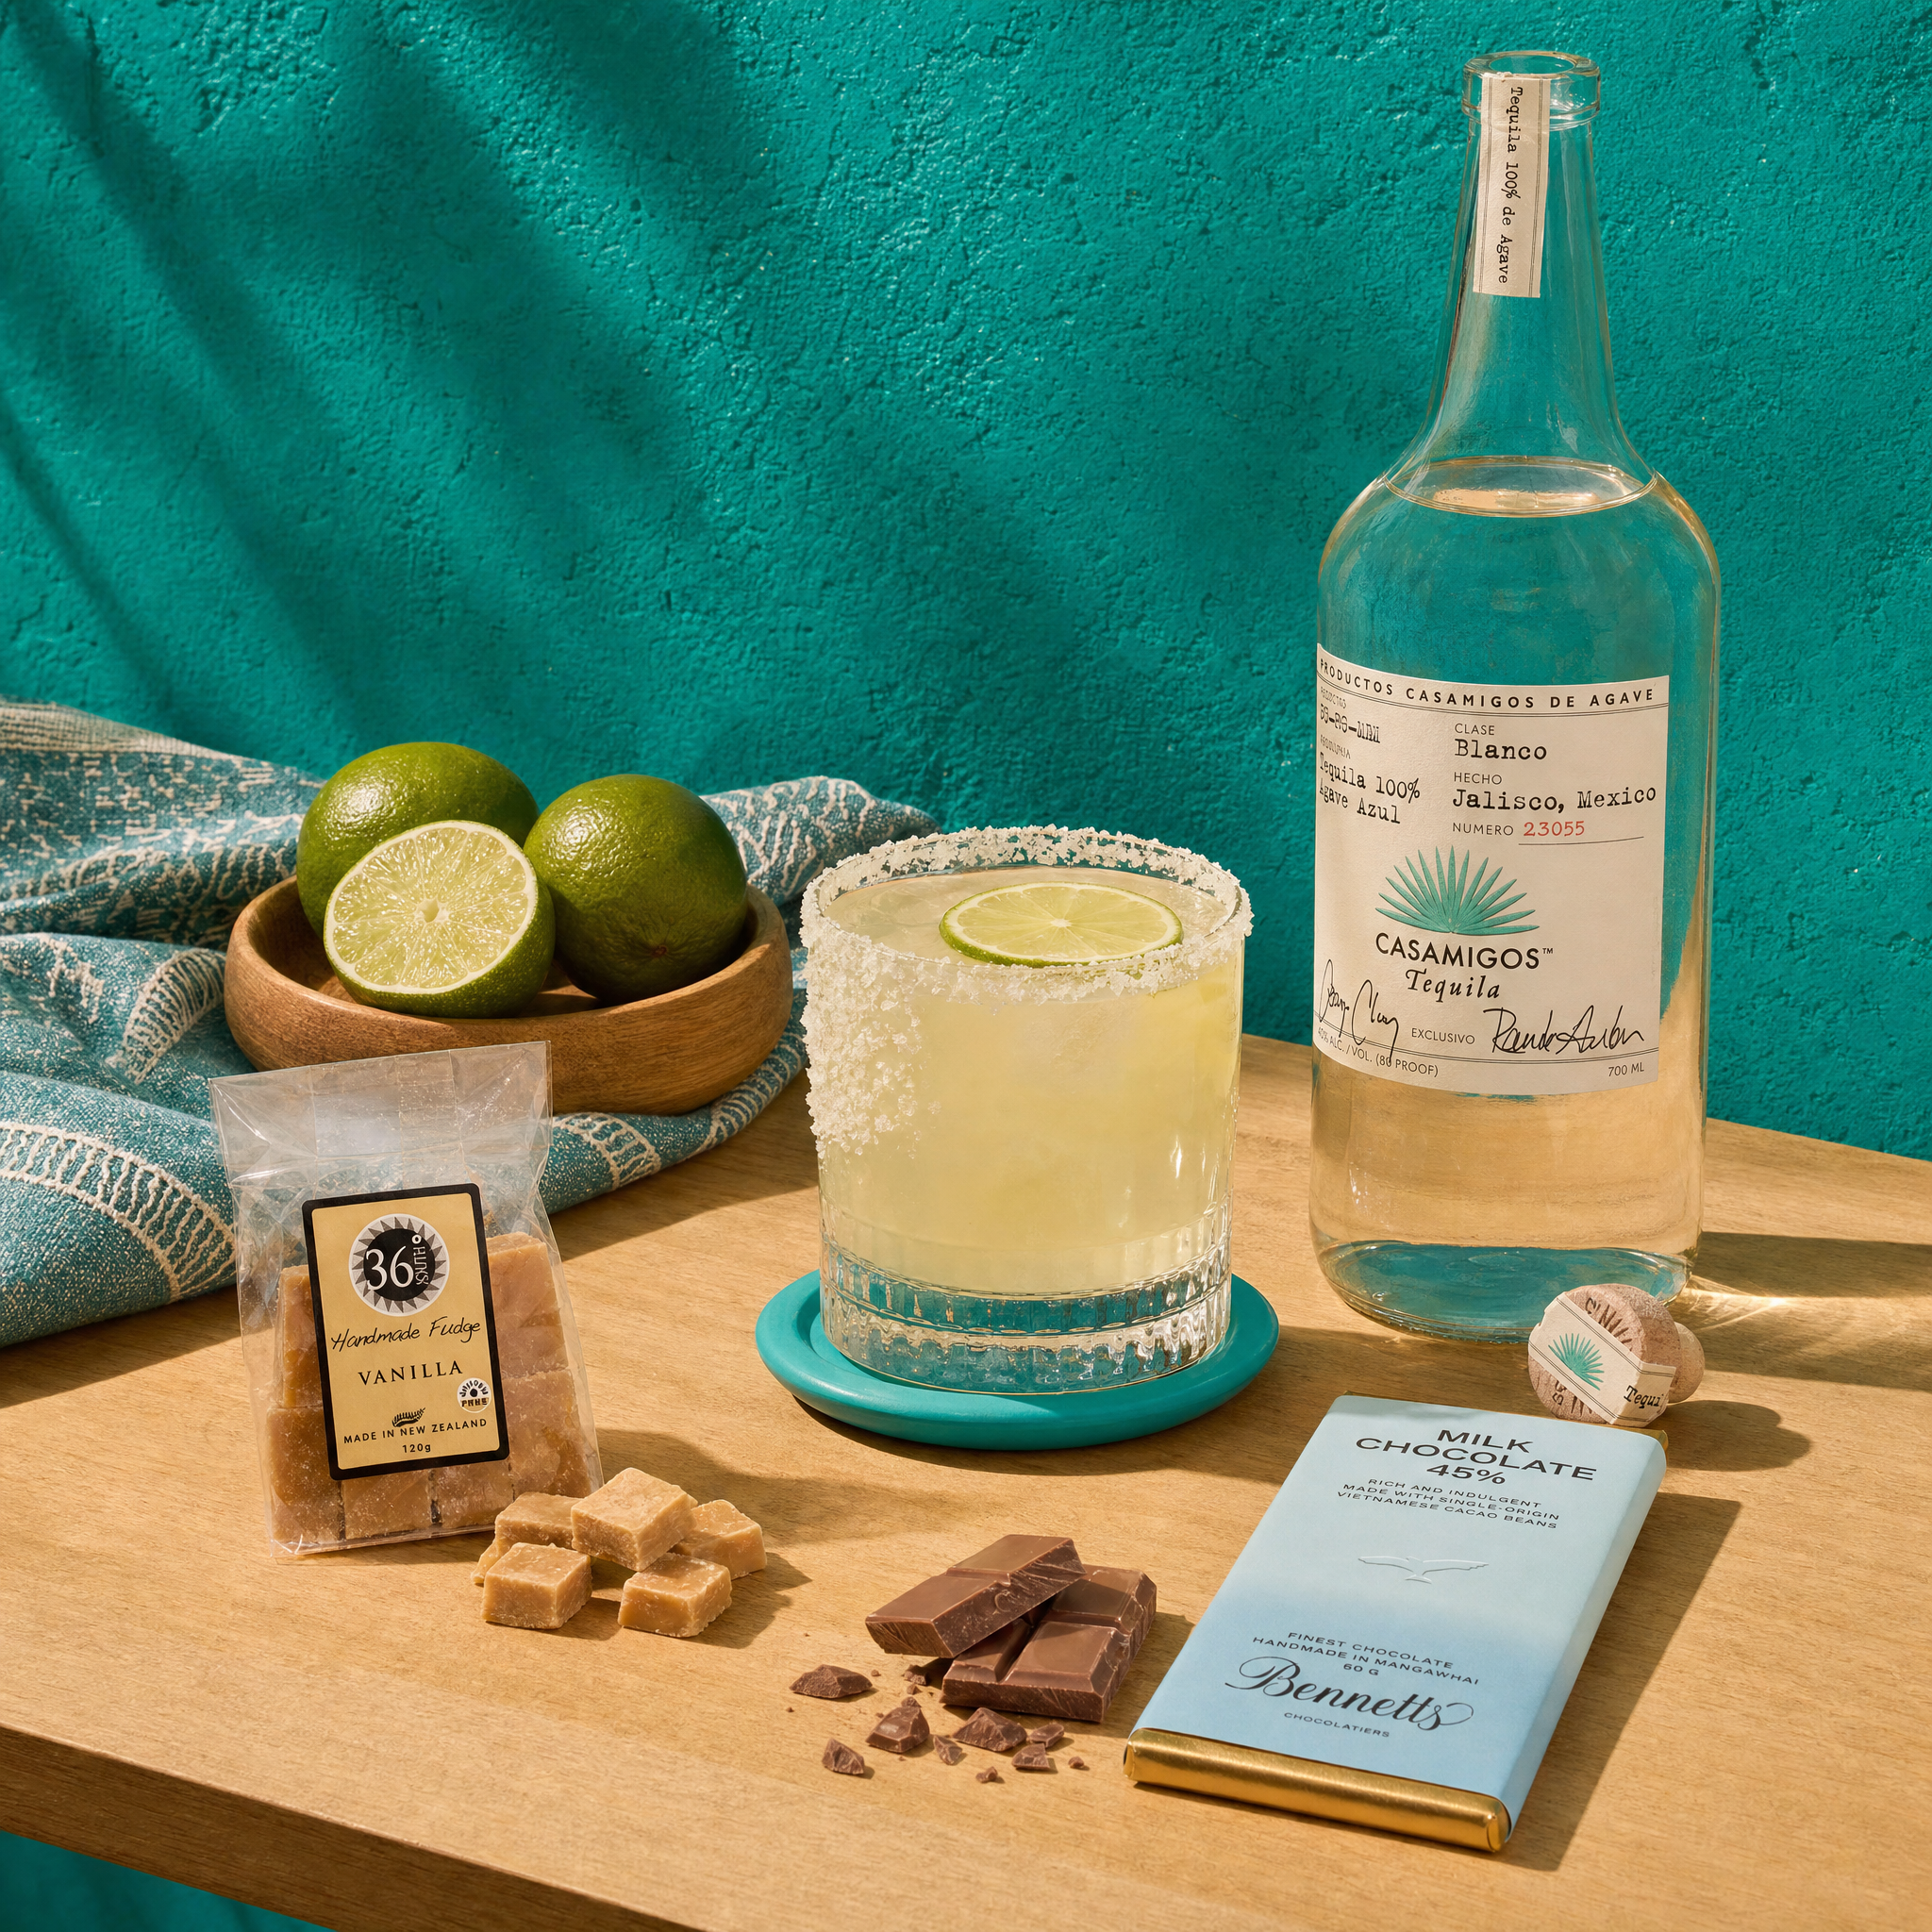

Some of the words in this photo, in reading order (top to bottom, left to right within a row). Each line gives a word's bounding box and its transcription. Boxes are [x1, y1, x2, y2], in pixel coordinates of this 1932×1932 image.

[1506, 87, 1523, 153] Tequila
[1501, 162, 1521, 199] 100%
[1501, 206, 1516, 226] de
[1496, 234, 1513, 284] Agave
[1321, 658, 1393, 695] PRODUCTOS
[1406, 688, 1534, 708] CASAMIGOS
[1550, 695, 1575, 708] DE
[1590, 688, 1654, 707] AGAVE
[1455, 723, 1495, 736] CLASE
[1455, 738, 1547, 760] Blanco
[1320, 752, 1367, 790] Tequila
[1376, 775, 1421, 804] 100%
[1454, 772, 1503, 785] HECHO
[1320, 777, 1348, 808] Agave
[1357, 797, 1401, 824] Azul
[1452, 789, 1565, 814] Jalisco,
[1577, 786, 1657, 809] Mexico
[1452, 823, 1514, 836] NUMERO
[1524, 820, 1585, 837] 23055
[1406, 969, 1500, 1003] Tequila
[1411, 1027, 1475, 1045] EXCLUSIVO
[1376, 1053, 1391, 1067] (80
[1395, 1058, 1439, 1077] PROOF)
[1608, 1064, 1627, 1076] 700
[1631, 1062, 1644, 1074] ML
[331, 1323, 421, 1352] Handmade
[428, 1316, 481, 1343] Fudge
[358, 1360, 463, 1386] VANILLA
[343, 1431, 377, 1444] MADE
[382, 1429, 394, 1439] IN
[400, 1425, 426, 1437] NEW
[432, 1418, 487, 1433] ZEALAND
[1437, 1429, 1533, 1454] MILK
[402, 1443, 432, 1454] 120g
[1356, 1438, 1597, 1481] CHOCOLATE
[1426, 1464, 1506, 1485] 45%
[1343, 1484, 1389, 1495] MADE
[1394, 1491, 1435, 1502] WITH
[1439, 1496, 1560, 1521] SINGLE-ORIGIN
[1368, 1478, 1406, 1489] RICH
[1410, 1484, 1444, 1494] AND
[1449, 1489, 1542, 1508] INDULGENT
[1338, 1491, 1440, 1510] VIETNAMESE
[1444, 1506, 1498, 1519] CACAO
[1504, 1515, 1557, 1529] BEANS
[1253, 1637, 1348, 1659] HANDMADE
[1353, 1655, 1369, 1663] IN
[1374, 1657, 1479, 1685] MANGAWHAI
[1288, 1632, 1347, 1648] FINEST
[1352, 1643, 1454, 1669] CHOCOLATE
[1343, 1663, 1364, 1673] 60
[1369, 1668, 1380, 1676] G
[1224, 1656, 1474, 1731] Bennetts
[1284, 1712, 1391, 1738] CHOCOLATIERS
